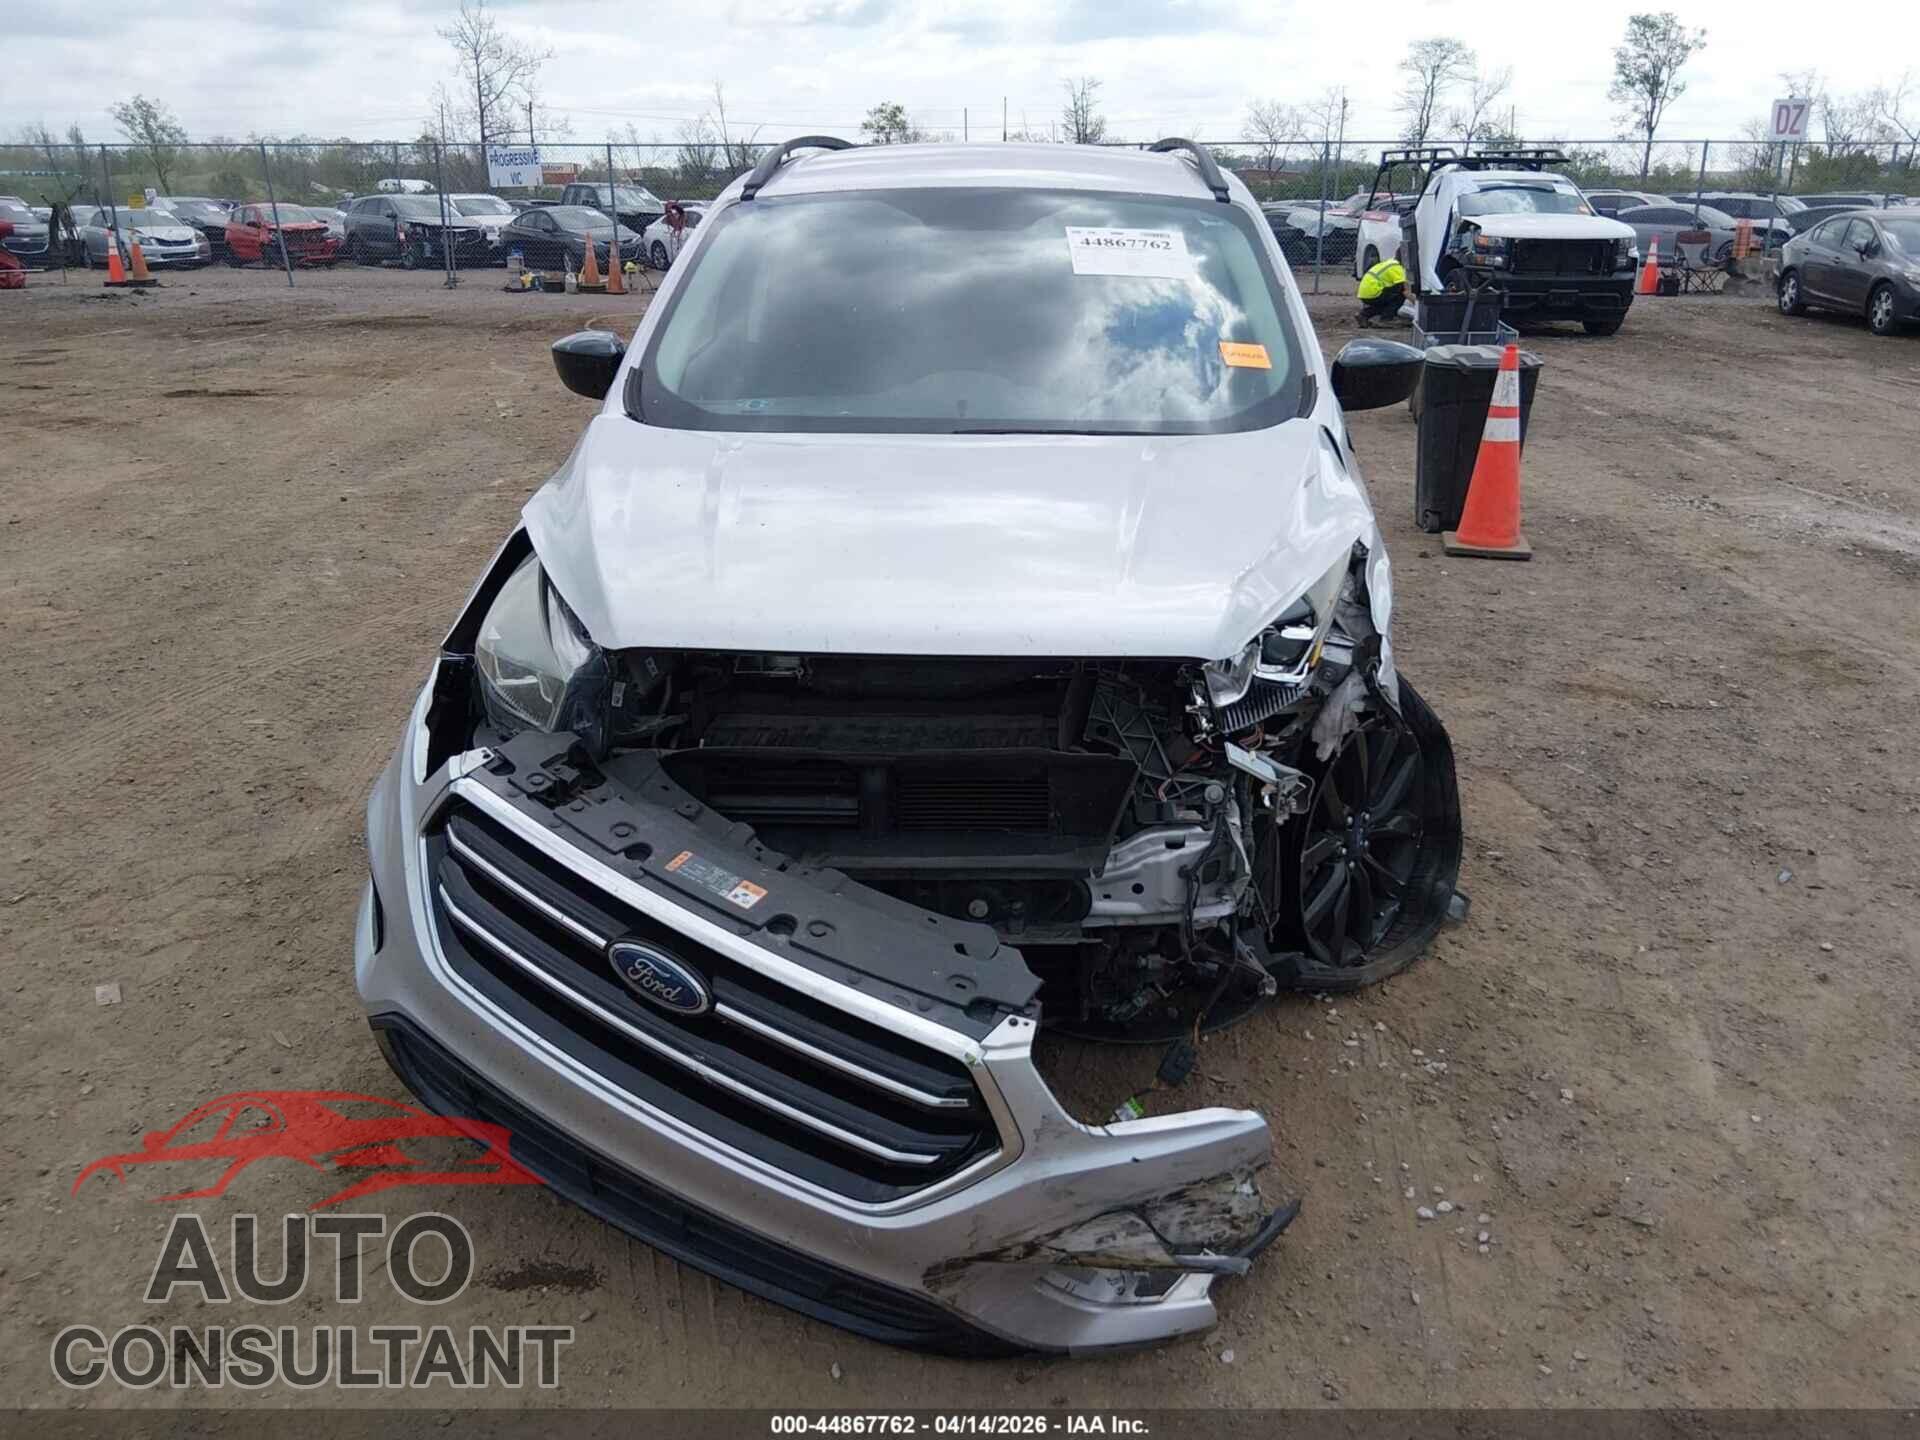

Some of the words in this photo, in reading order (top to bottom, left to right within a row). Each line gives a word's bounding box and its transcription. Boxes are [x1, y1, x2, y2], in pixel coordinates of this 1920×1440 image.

[489, 148, 539, 167] PROGRESSIVE
[510, 171, 522, 185] VIC
[1080, 237, 1173, 251] 44867762
[627, 958, 683, 1002] Ford
